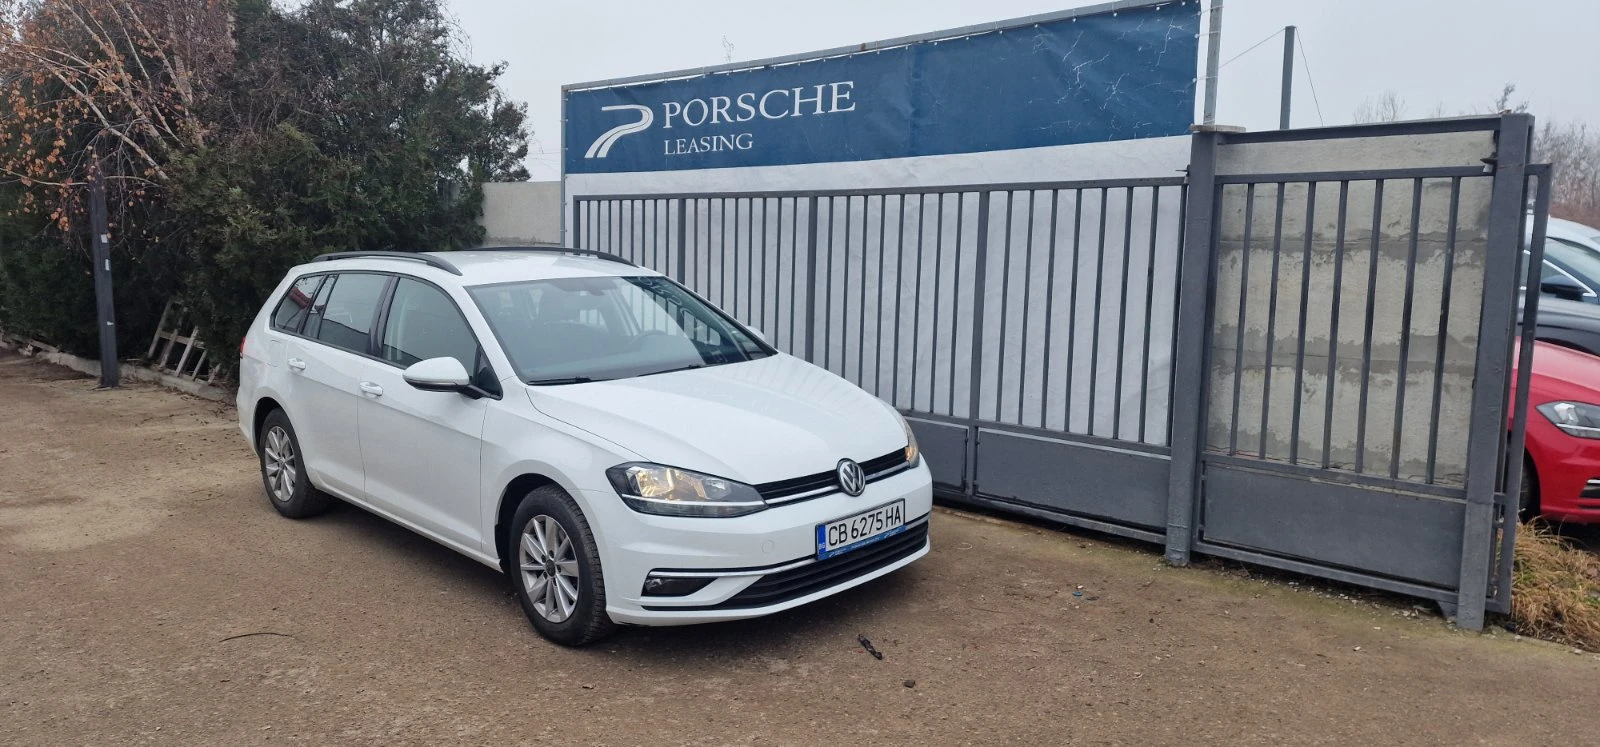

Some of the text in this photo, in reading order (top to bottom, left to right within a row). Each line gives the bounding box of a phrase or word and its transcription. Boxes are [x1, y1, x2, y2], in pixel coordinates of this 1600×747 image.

[662, 80, 856, 129] PORSCHE
[664, 132, 754, 155] LEASING
[828, 523, 848, 546] CB
[851, 511, 883, 539] 6275
[885, 505, 901, 528] HA
